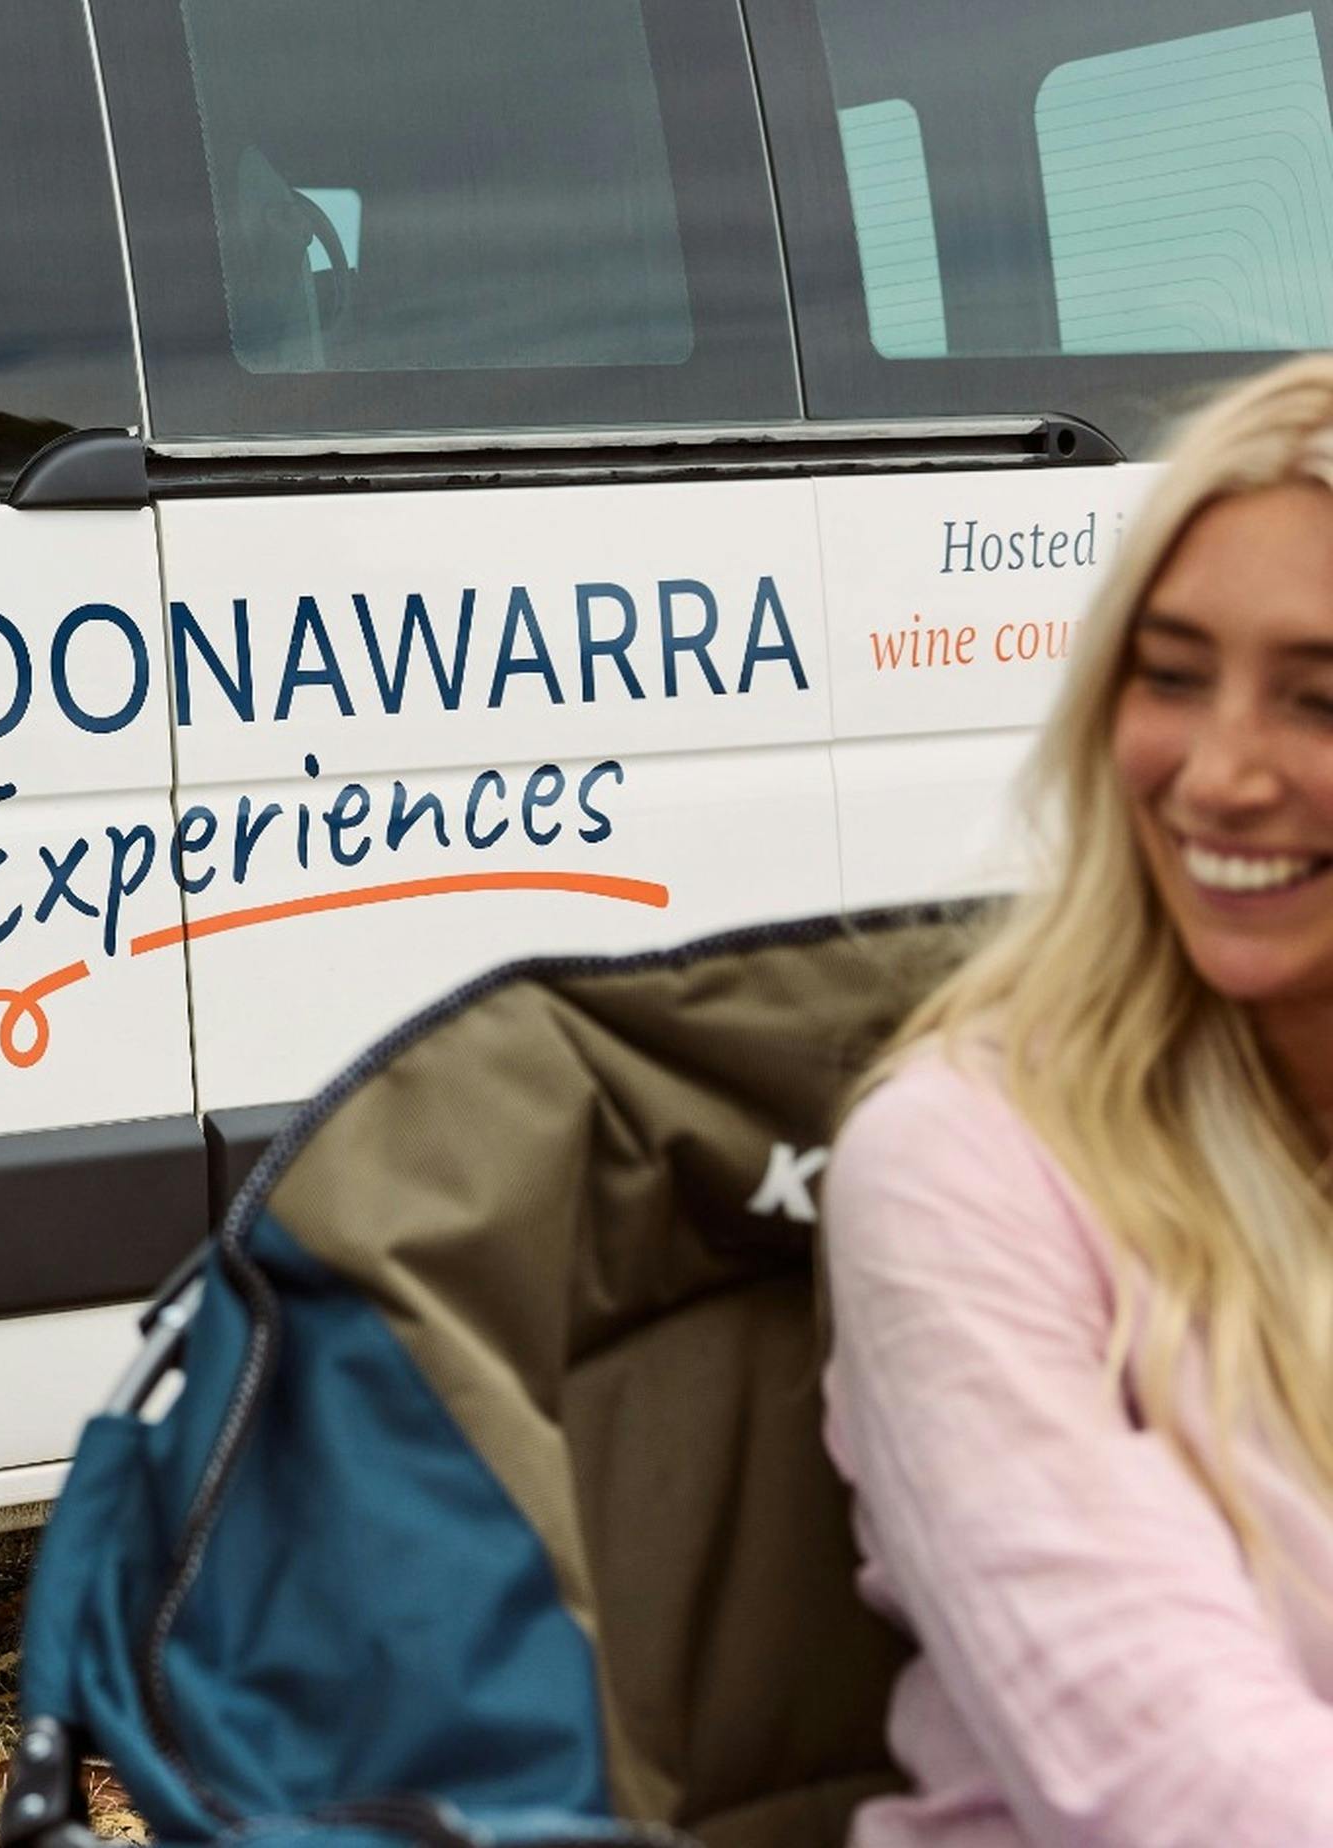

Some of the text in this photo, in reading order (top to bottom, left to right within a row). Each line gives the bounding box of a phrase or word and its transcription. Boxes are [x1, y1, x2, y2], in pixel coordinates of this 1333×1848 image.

[940, 511, 1097, 574] Hosted
[869, 613, 1075, 671] wine cou
